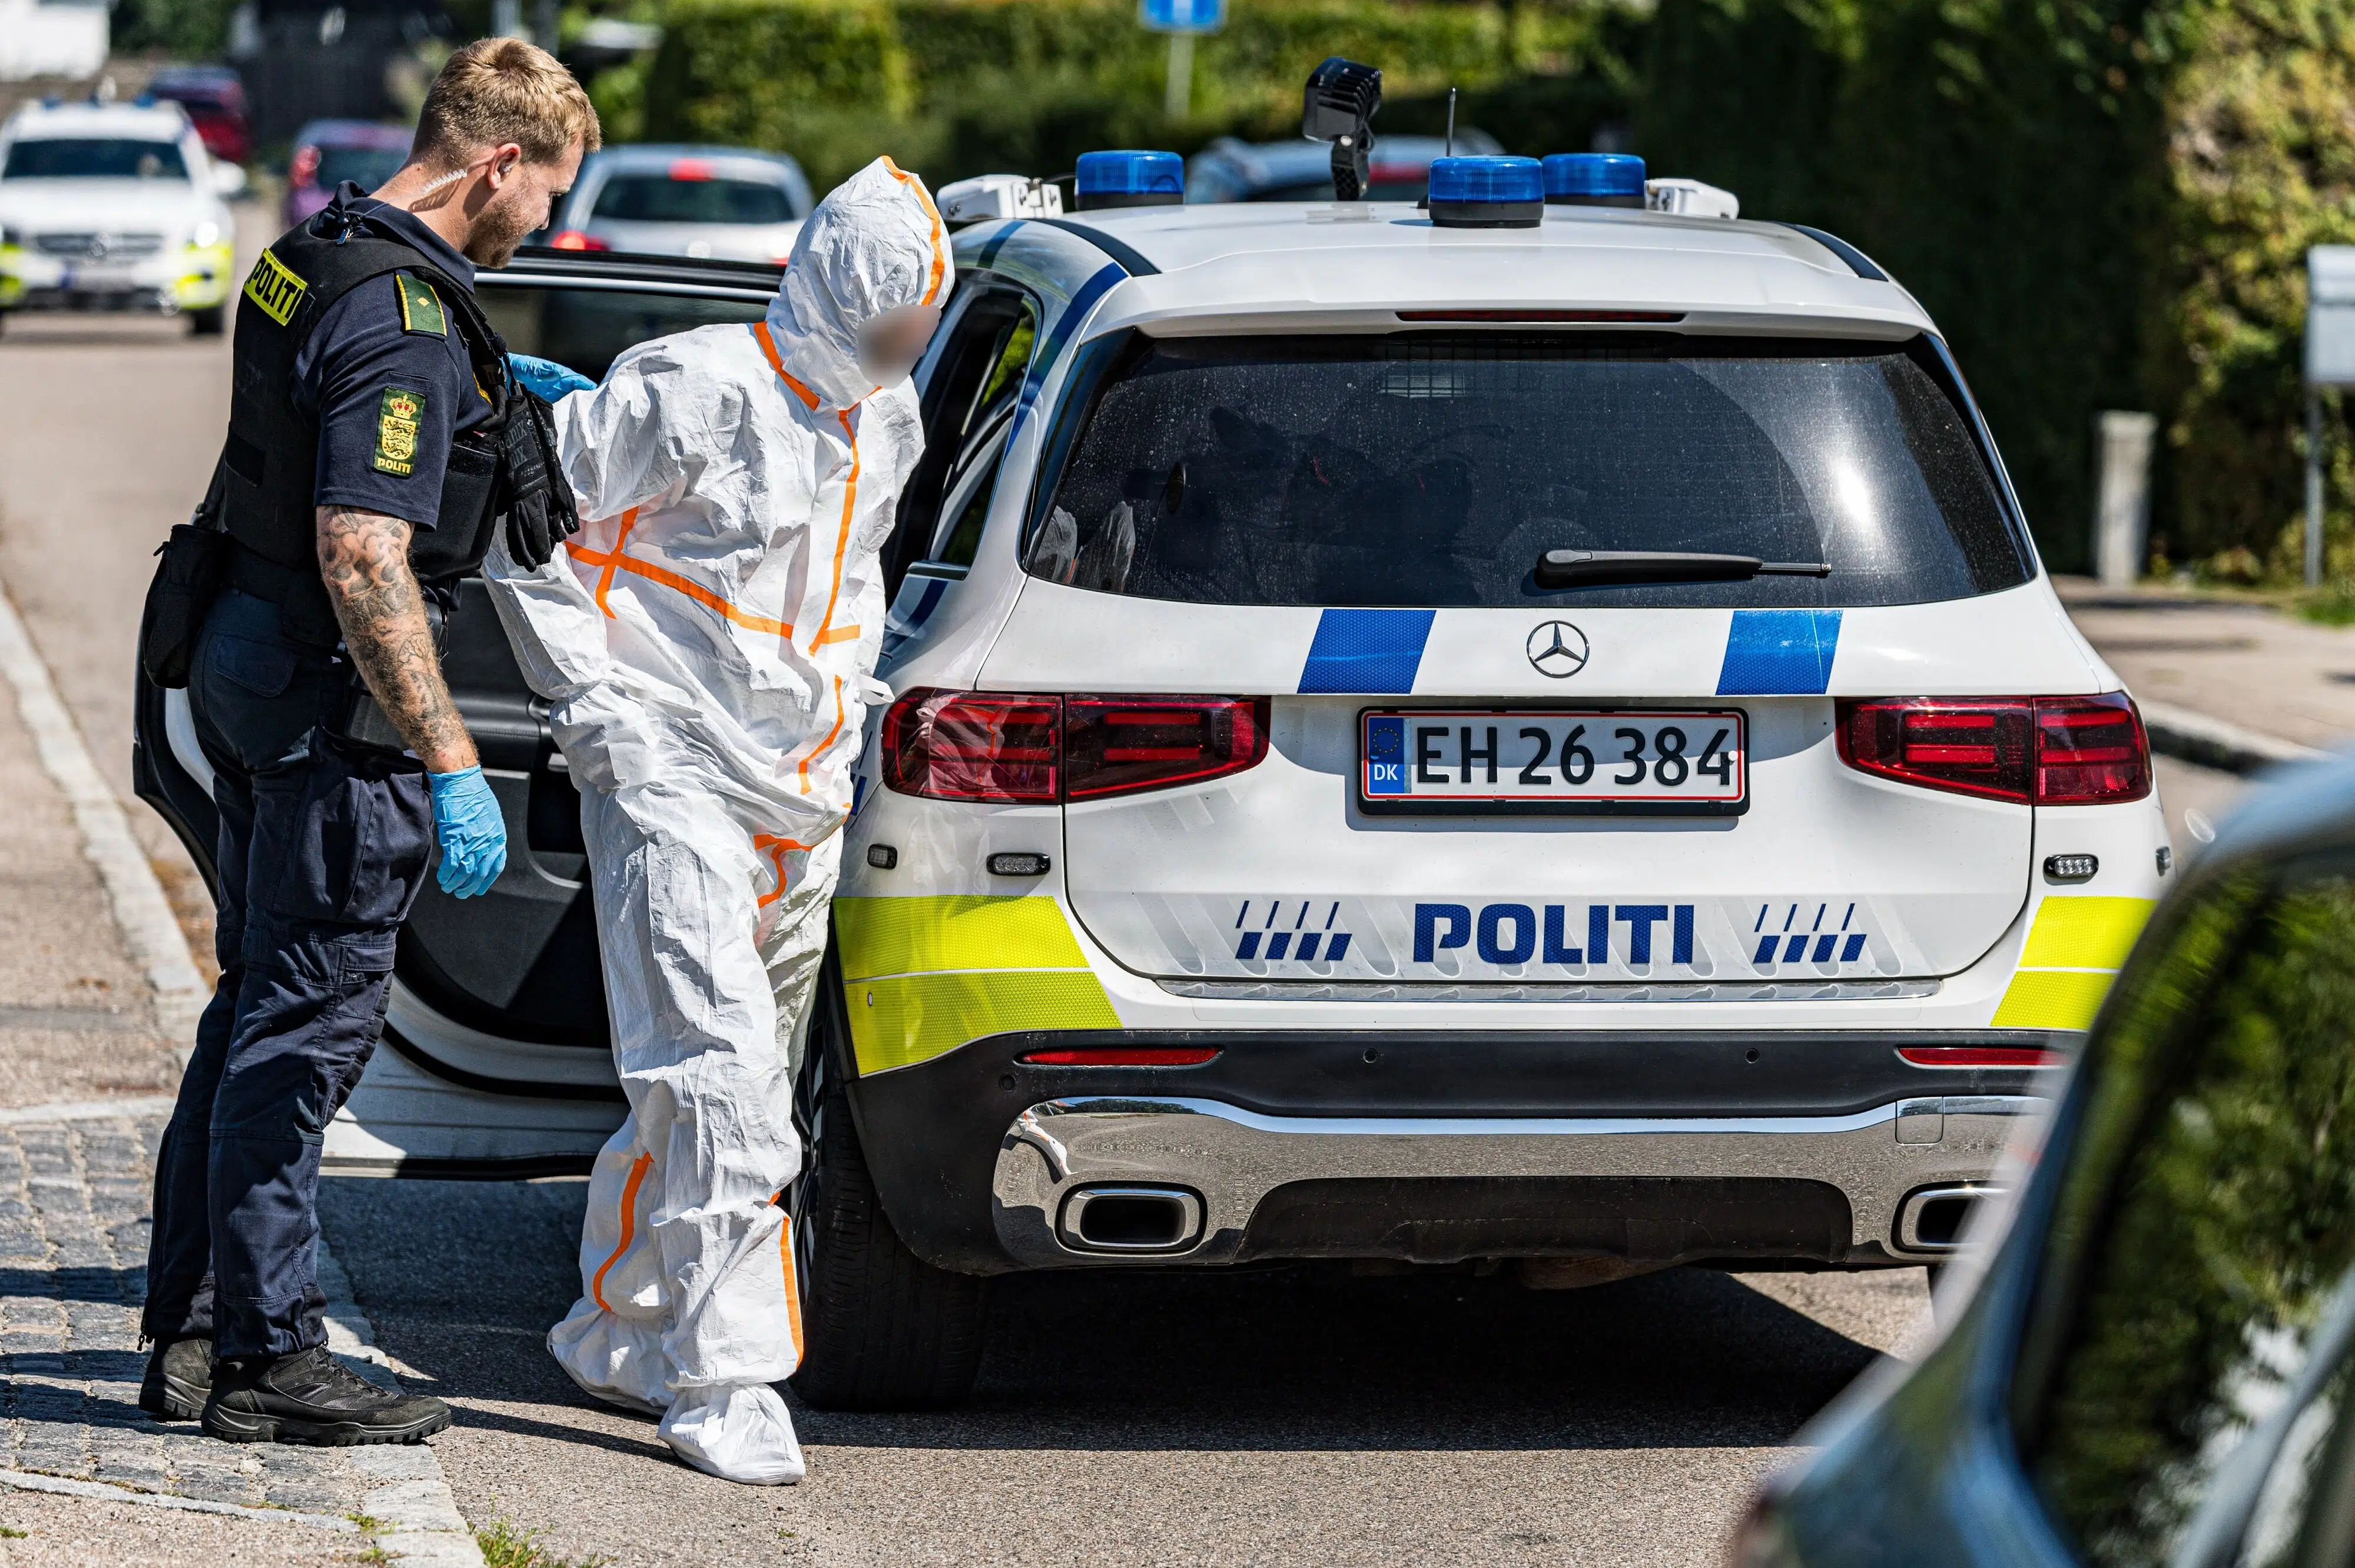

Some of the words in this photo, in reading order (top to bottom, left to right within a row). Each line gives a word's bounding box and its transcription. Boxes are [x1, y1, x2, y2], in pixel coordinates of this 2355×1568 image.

[246, 255, 303, 319] POLITI
[377, 457, 412, 474] POLITI
[1374, 764, 1398, 781] DK
[1416, 726, 1498, 784] EH
[1519, 725, 1595, 785] 26
[1614, 726, 1730, 786] 384
[1413, 903, 1694, 964] POLITI
